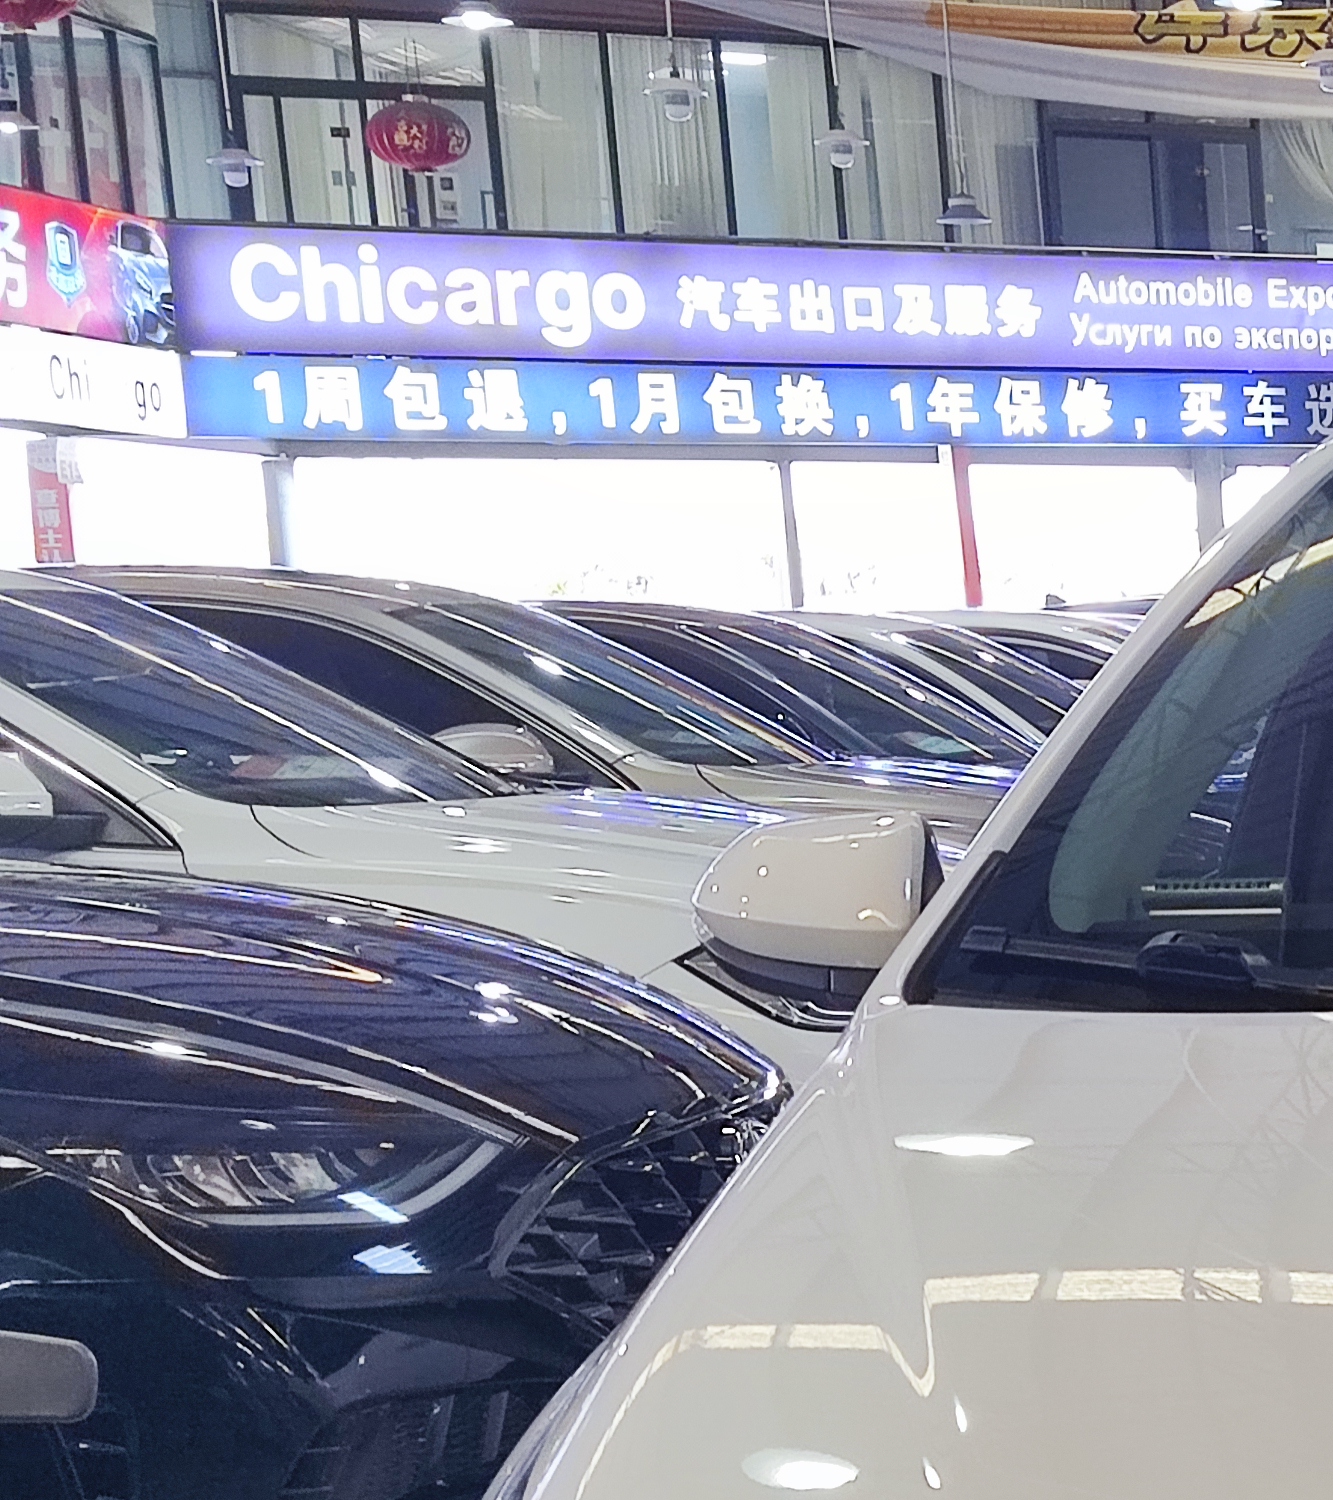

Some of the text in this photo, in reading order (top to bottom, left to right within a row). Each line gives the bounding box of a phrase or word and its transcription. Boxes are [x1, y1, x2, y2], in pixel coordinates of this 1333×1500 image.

[229, 242, 646, 348] Chicargo
[676, 274, 1043, 338] 汽车出口及服务
[1073, 273, 1253, 309] Automobile
[1069, 312, 1172, 352] Услуги
[1185, 326, 1222, 349] по
[49, 354, 162, 421] Chigo
